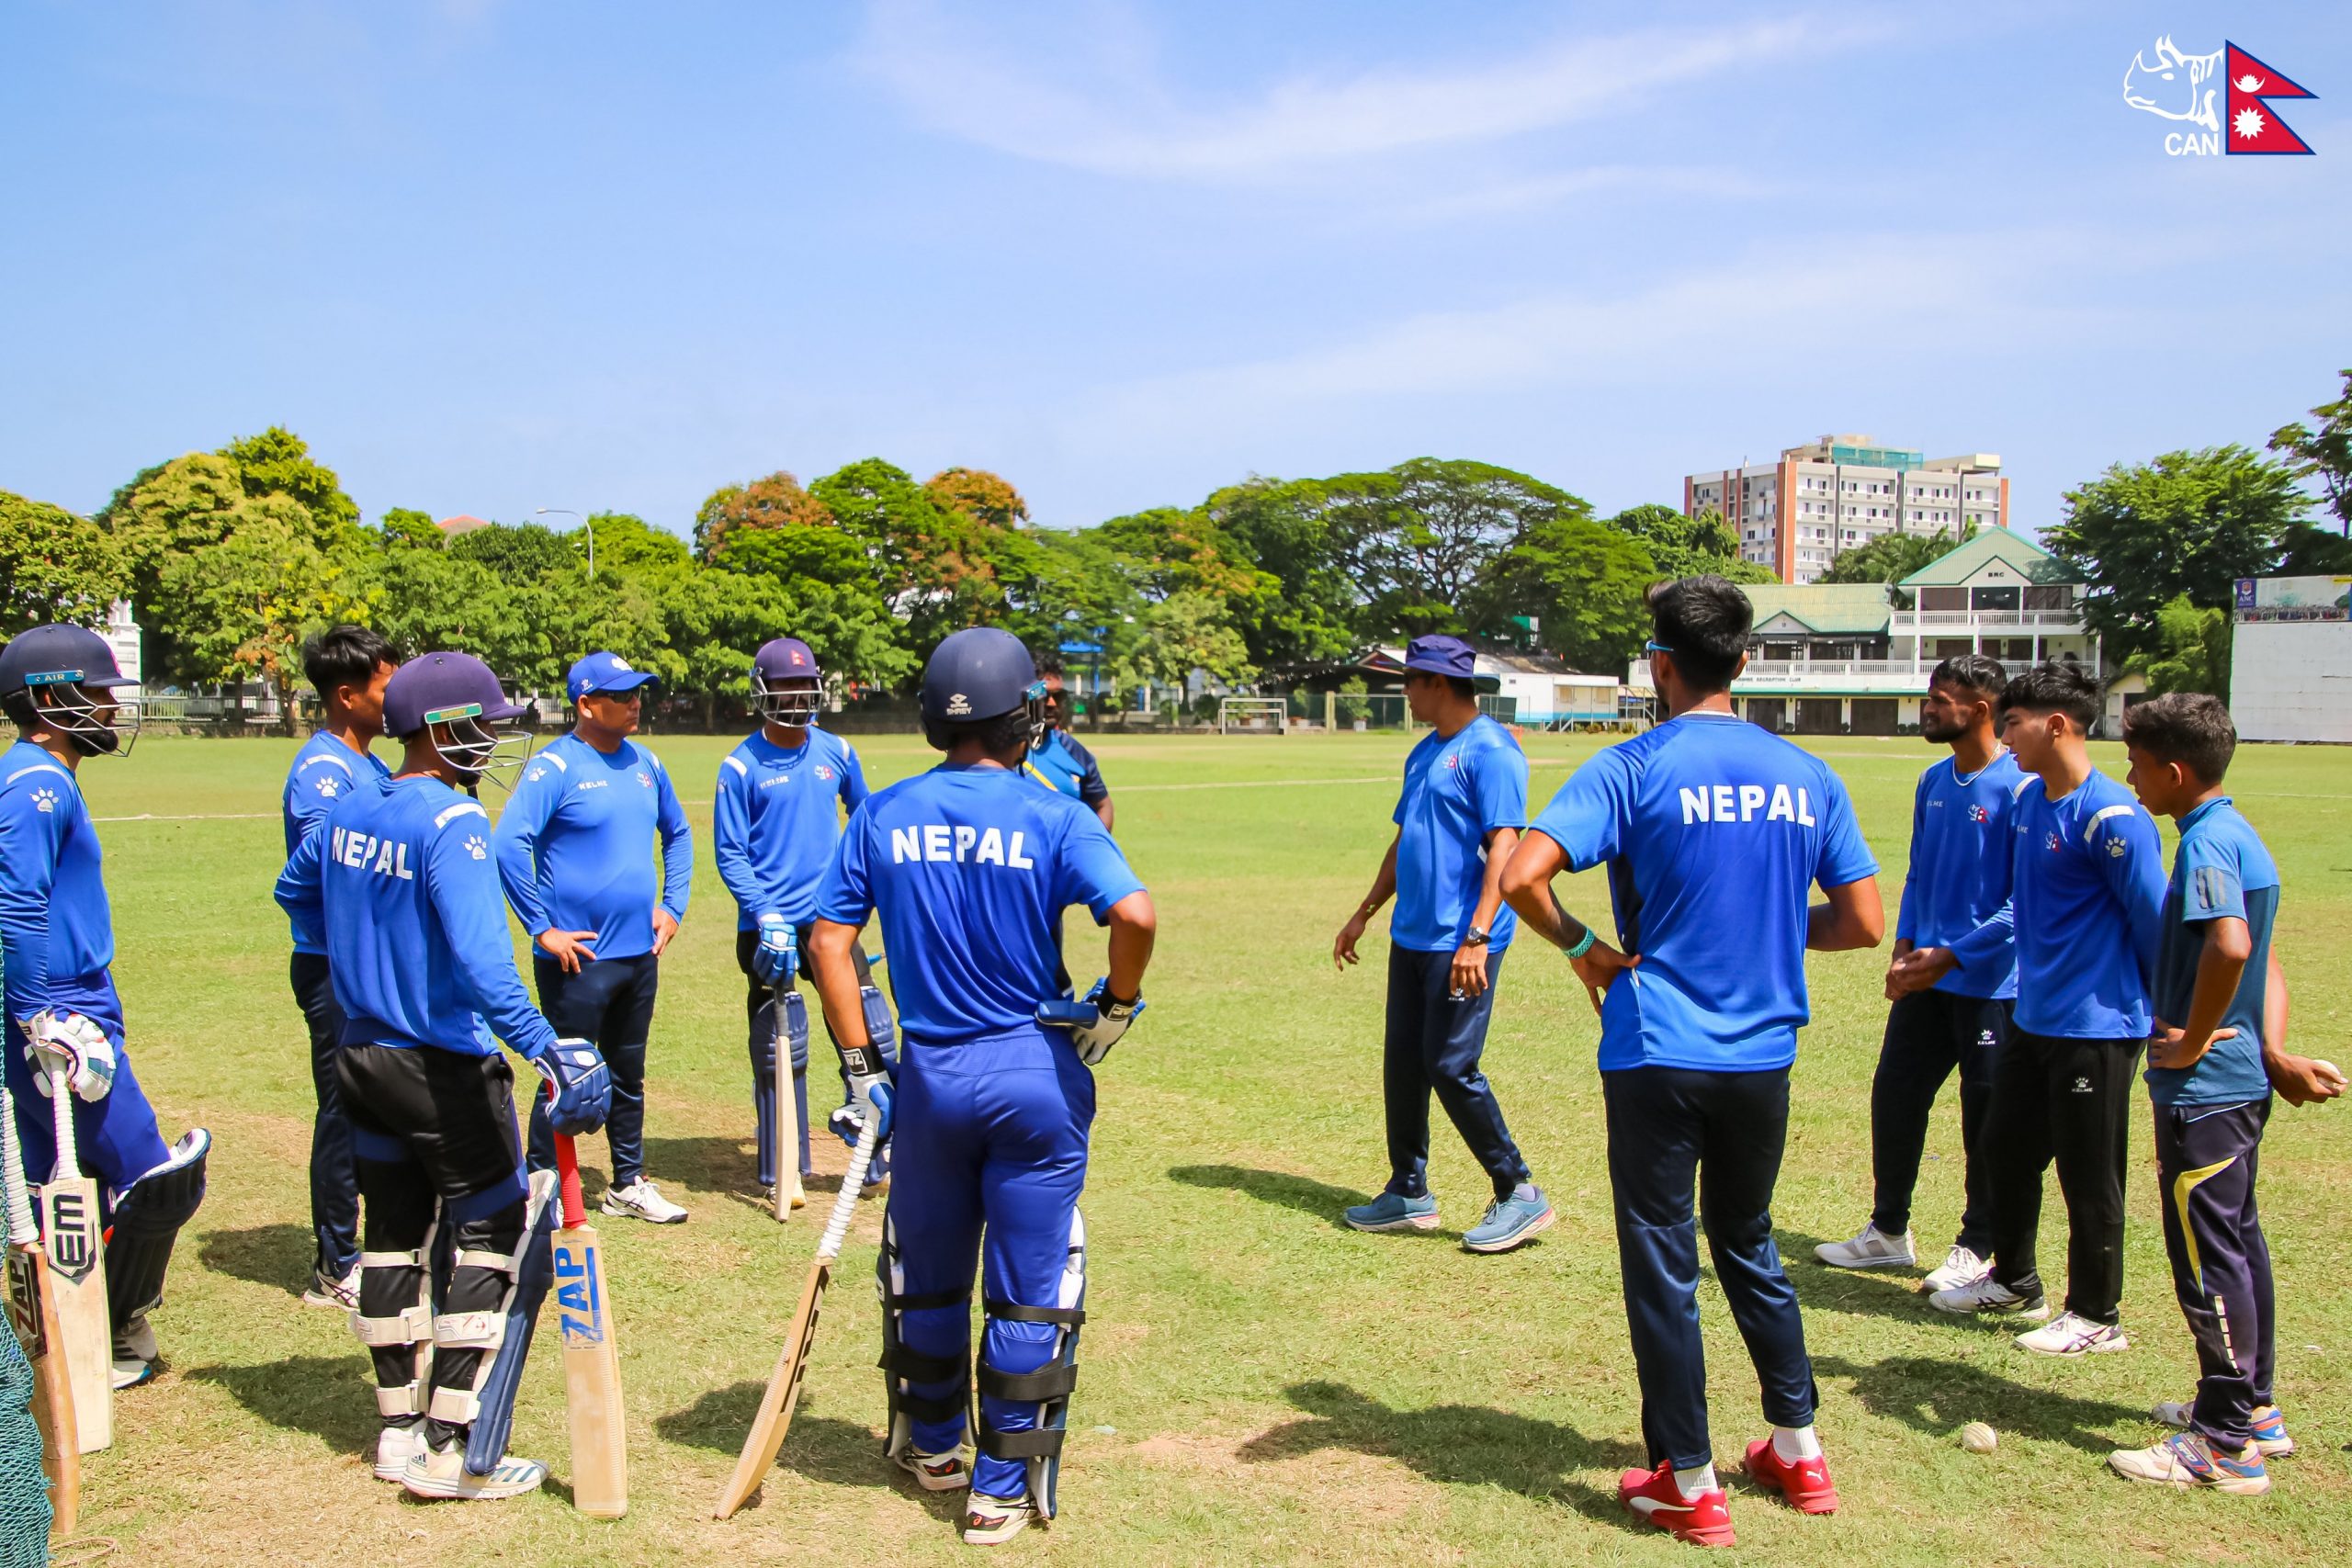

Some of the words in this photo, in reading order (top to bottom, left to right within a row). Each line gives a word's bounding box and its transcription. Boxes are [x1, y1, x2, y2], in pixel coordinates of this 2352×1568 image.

[946, 706, 973, 716] SHREY
[1679, 784, 1815, 828] NEPAL
[332, 826, 413, 880] NEPAL
[891, 825, 1034, 870] NEPAL
[8, 1258, 38, 1337] ZAP
[554, 1247, 604, 1347] ZAP
